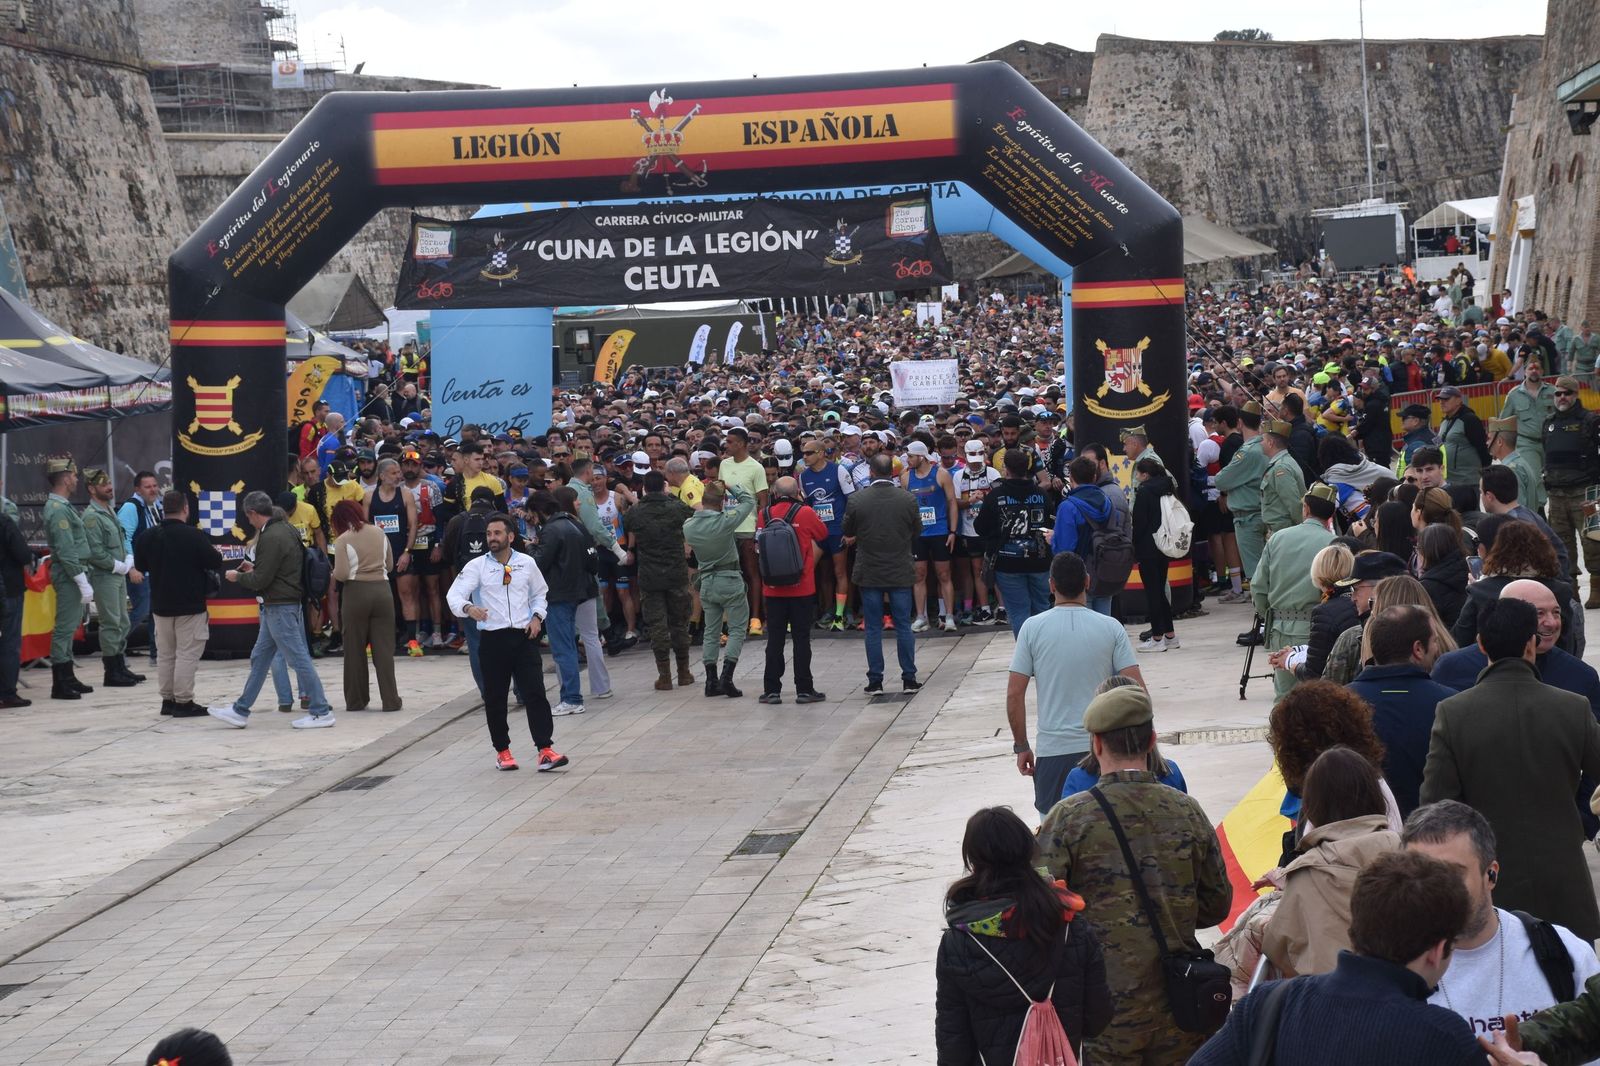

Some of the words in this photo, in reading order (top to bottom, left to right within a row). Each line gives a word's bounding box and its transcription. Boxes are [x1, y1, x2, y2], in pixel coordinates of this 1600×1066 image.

[452, 127, 561, 160] LEGIÓN
[742, 112, 899, 146] ESPAÑOLA
[252, 188, 267, 212] del
[266, 140, 320, 196] Legionario
[1056, 152, 1071, 163] de
[1068, 162, 1082, 174] la
[1082, 170, 1129, 215] Muerte
[595, 215, 649, 226] CARRERA
[653, 210, 743, 225] CÍVICO-MILITAR
[624, 237, 656, 258] DE
[665, 235, 697, 256] LA
[624, 264, 720, 291] CEUTA
[909, 373, 957, 381] PRINCESA
[912, 379, 960, 387] GABRIELA
[441, 377, 505, 405] Ceuta
[511, 382, 533, 396] es
